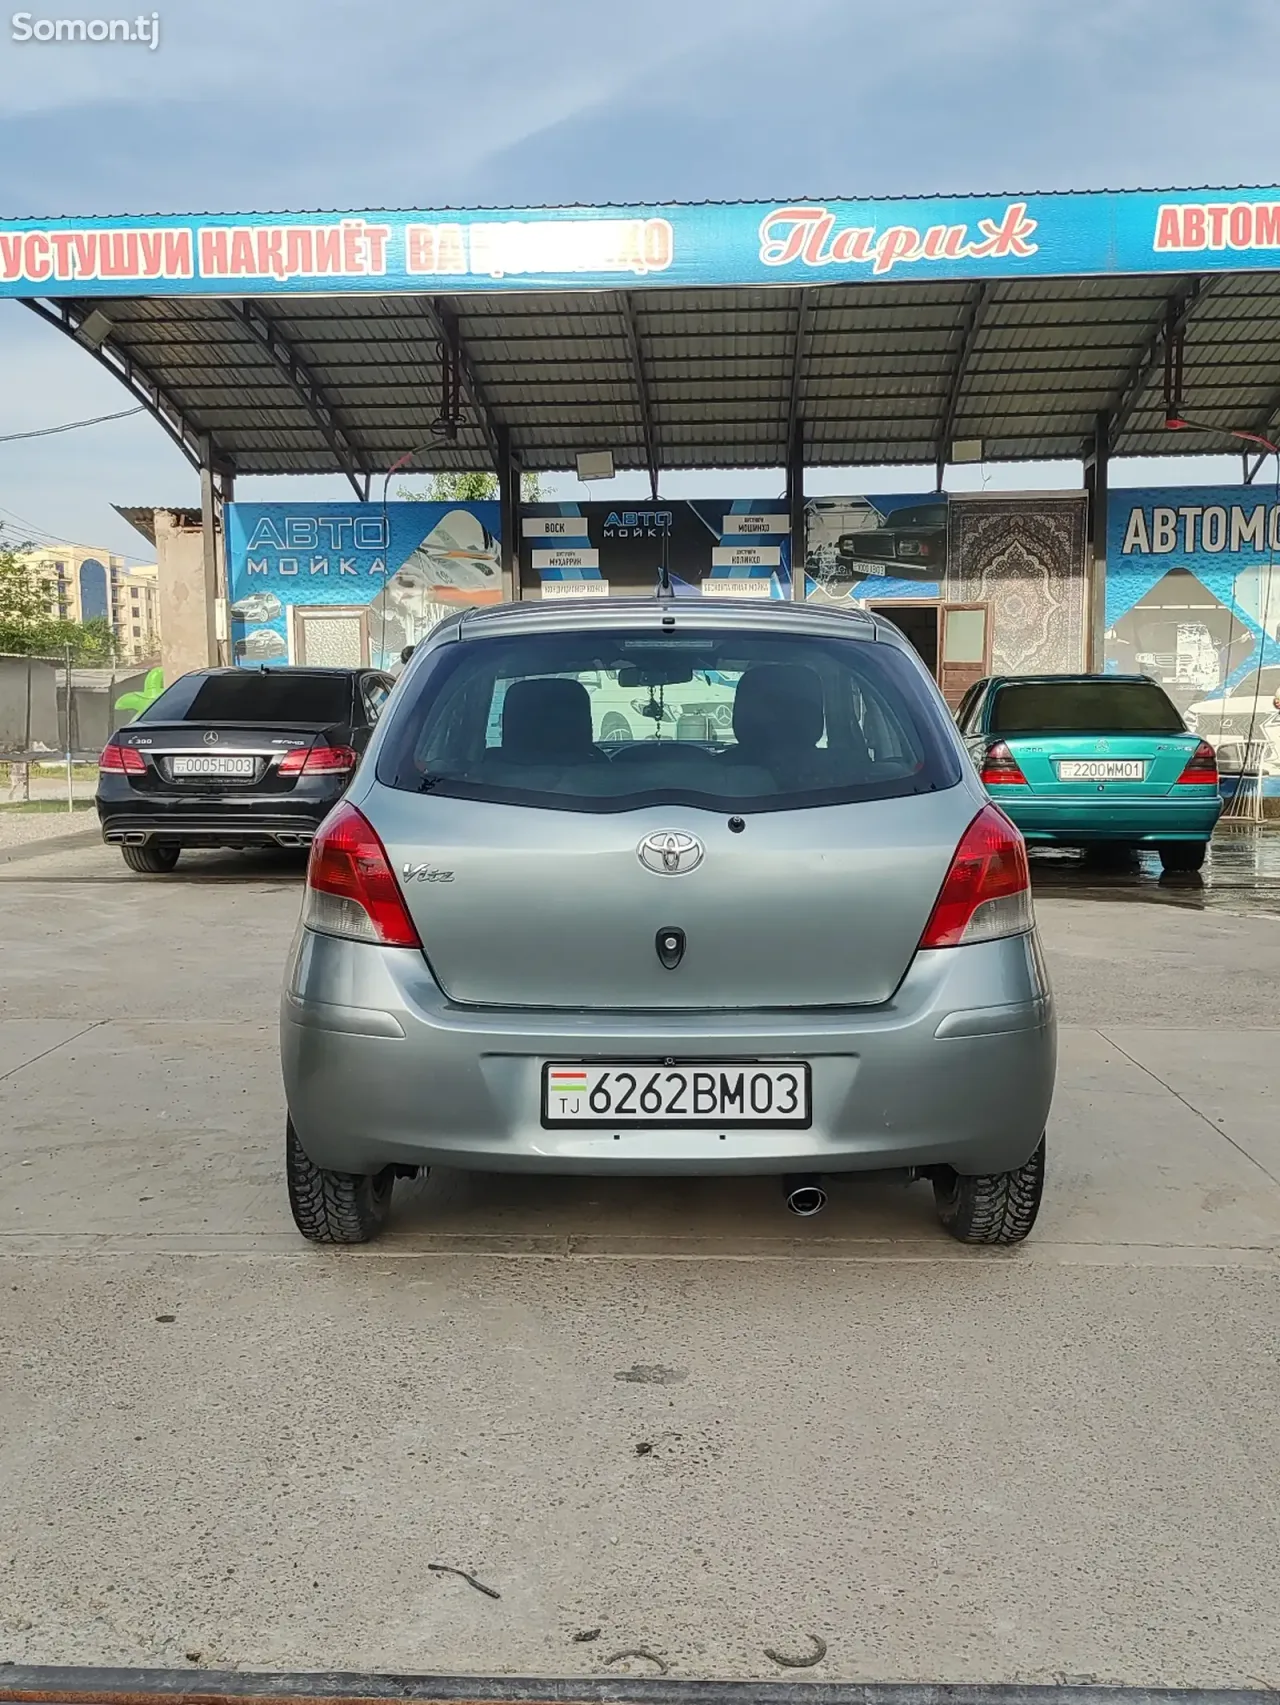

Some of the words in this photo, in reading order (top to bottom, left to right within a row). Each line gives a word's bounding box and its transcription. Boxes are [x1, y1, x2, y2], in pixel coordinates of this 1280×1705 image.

[761, 203, 1037, 273] Париж
[201, 222, 388, 277] НАҚЛИЁТ
[545, 522, 565, 533] ВОСК
[603, 511, 673, 527] АВТО
[246, 517, 390, 550] АВТО
[247, 555, 389, 575] МОЙКА
[186, 758, 252, 772] 0005HD03
[1073, 762, 1139, 777] 2200WM01
[402, 863, 455, 883] Vitz
[559, 1097, 580, 1114] TJ
[588, 1072, 799, 1114] 6262BM03
